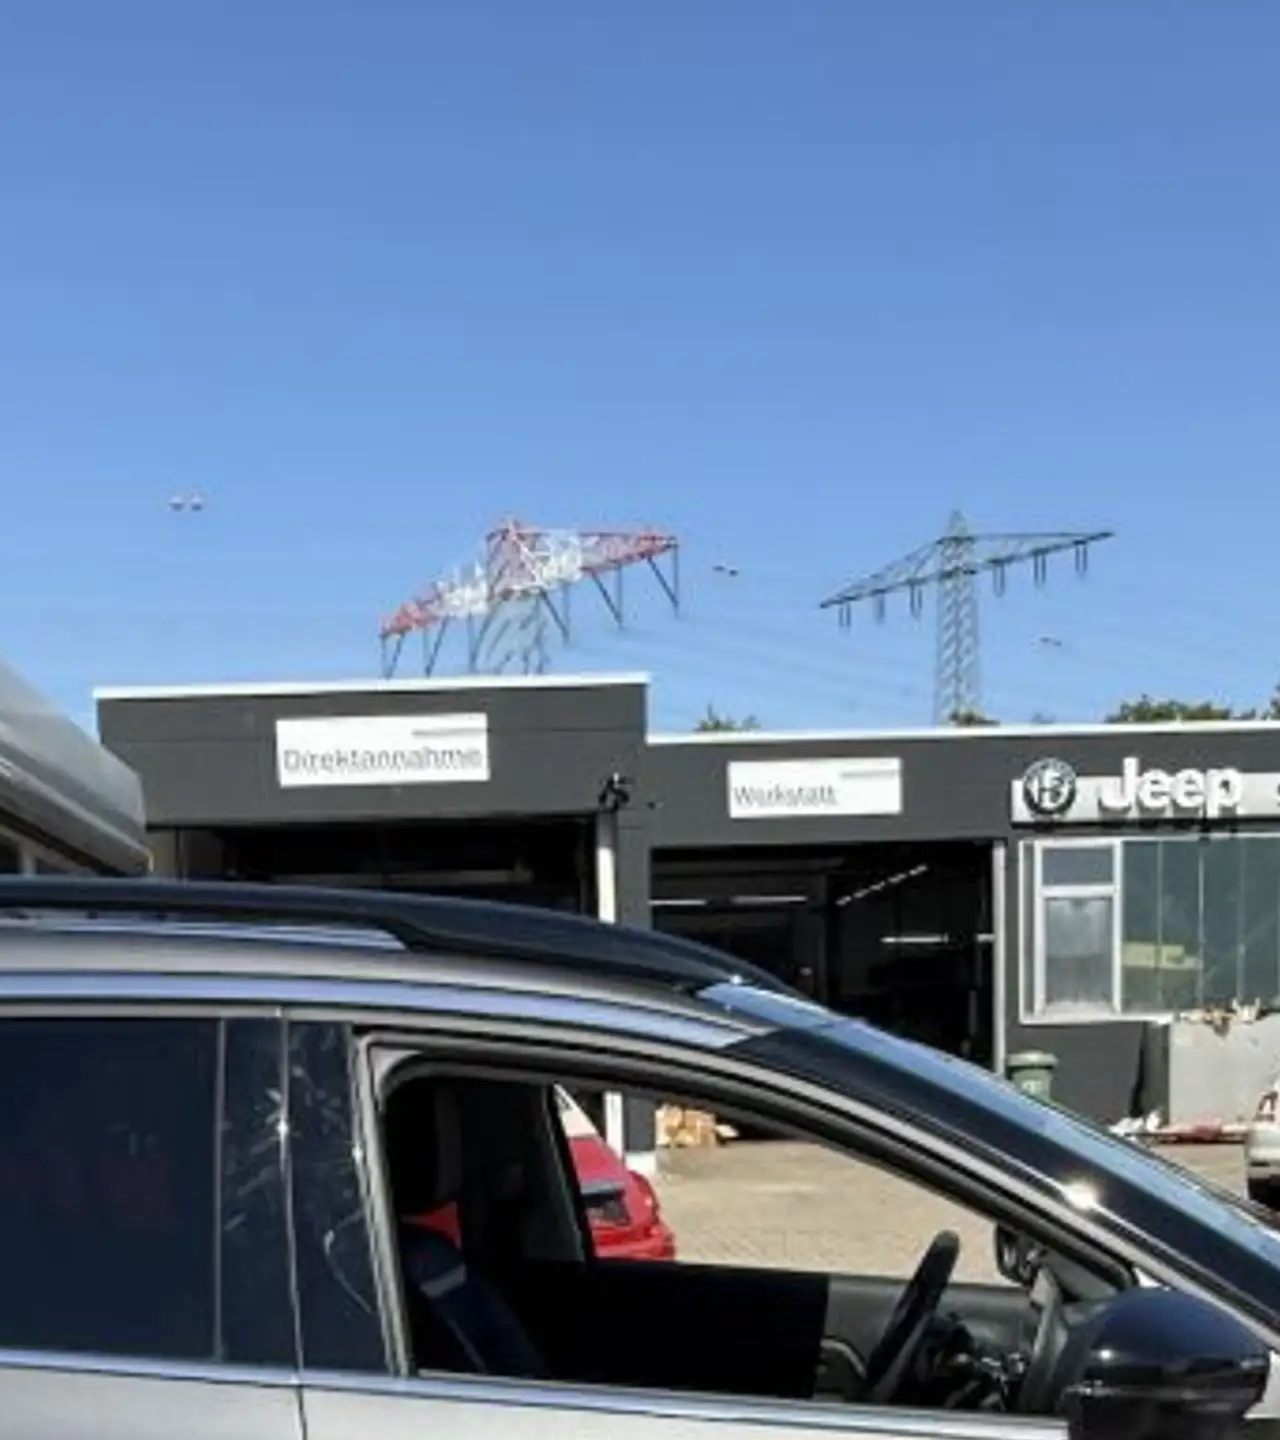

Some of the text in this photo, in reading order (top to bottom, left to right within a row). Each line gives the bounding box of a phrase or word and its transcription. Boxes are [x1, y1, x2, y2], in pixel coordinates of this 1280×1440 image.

[282, 747, 483, 774] Direktannahme
[733, 784, 838, 808] Werkstatt
[1099, 757, 1242, 818] Jeep
